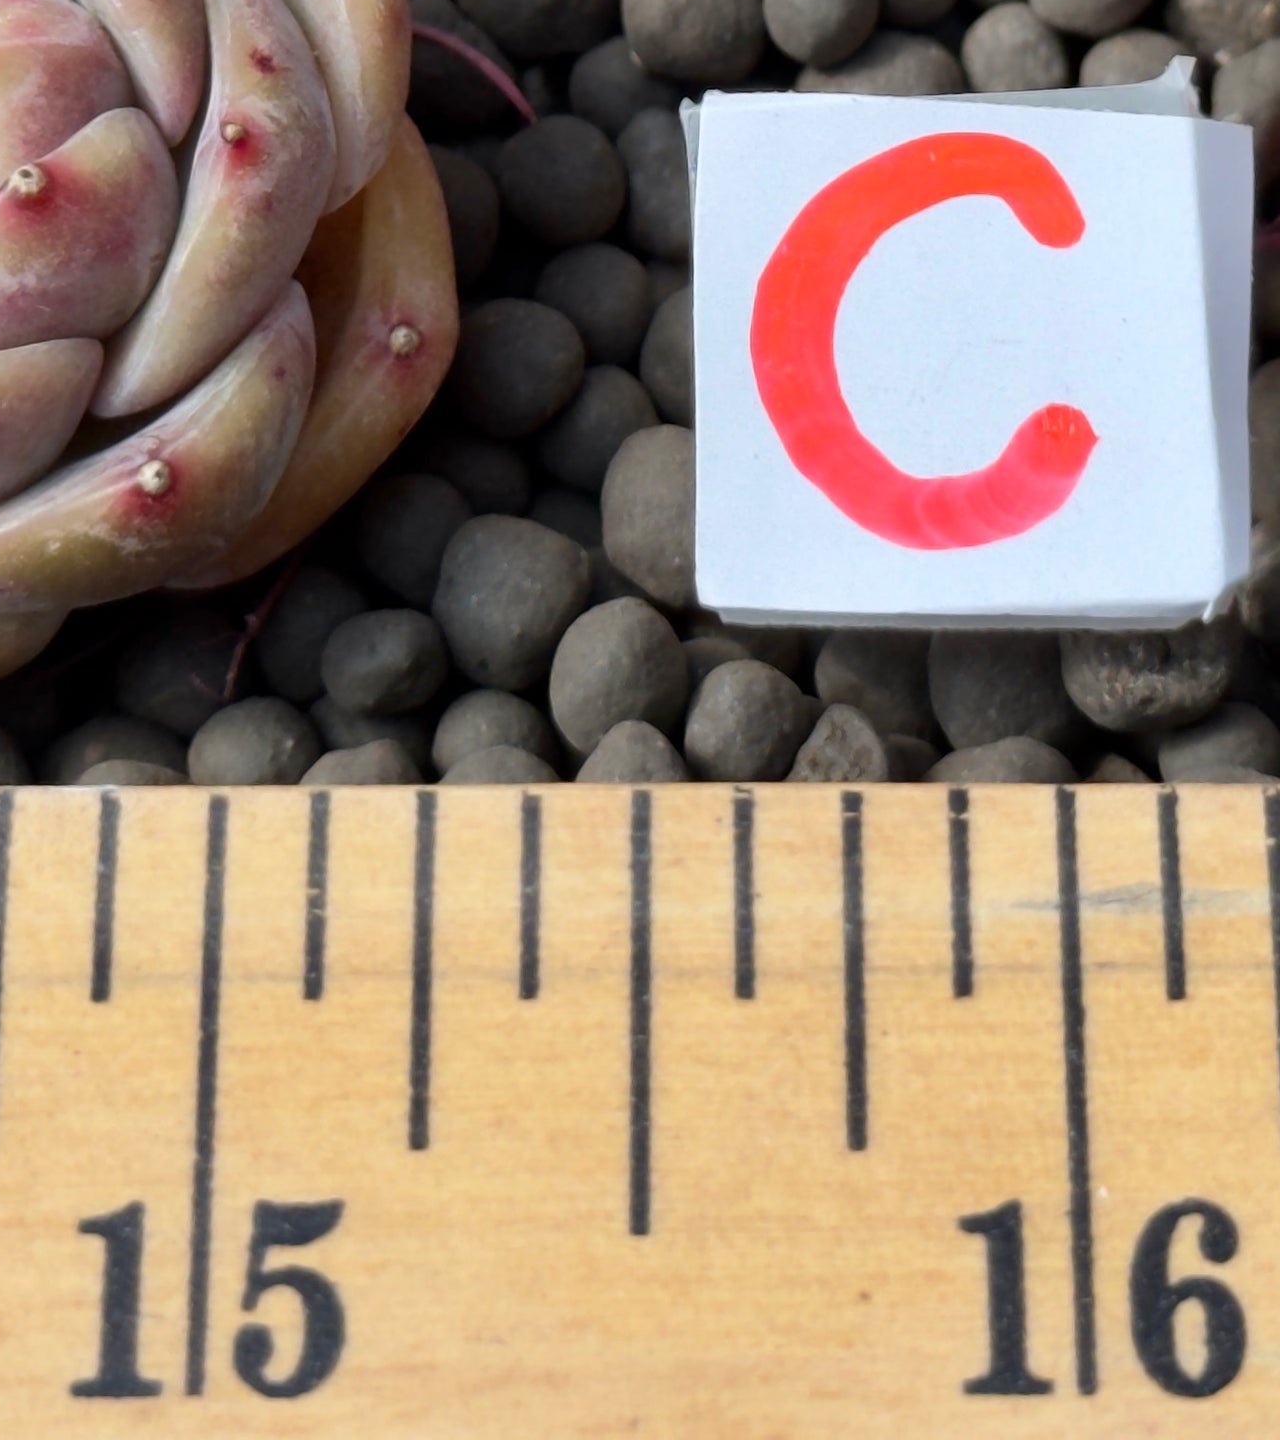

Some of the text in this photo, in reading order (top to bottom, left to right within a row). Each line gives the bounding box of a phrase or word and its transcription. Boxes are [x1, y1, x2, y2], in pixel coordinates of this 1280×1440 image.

[747, 131, 1101, 552] C
[71, 1199, 344, 1399] 15
[960, 1199, 1247, 1400] 16
